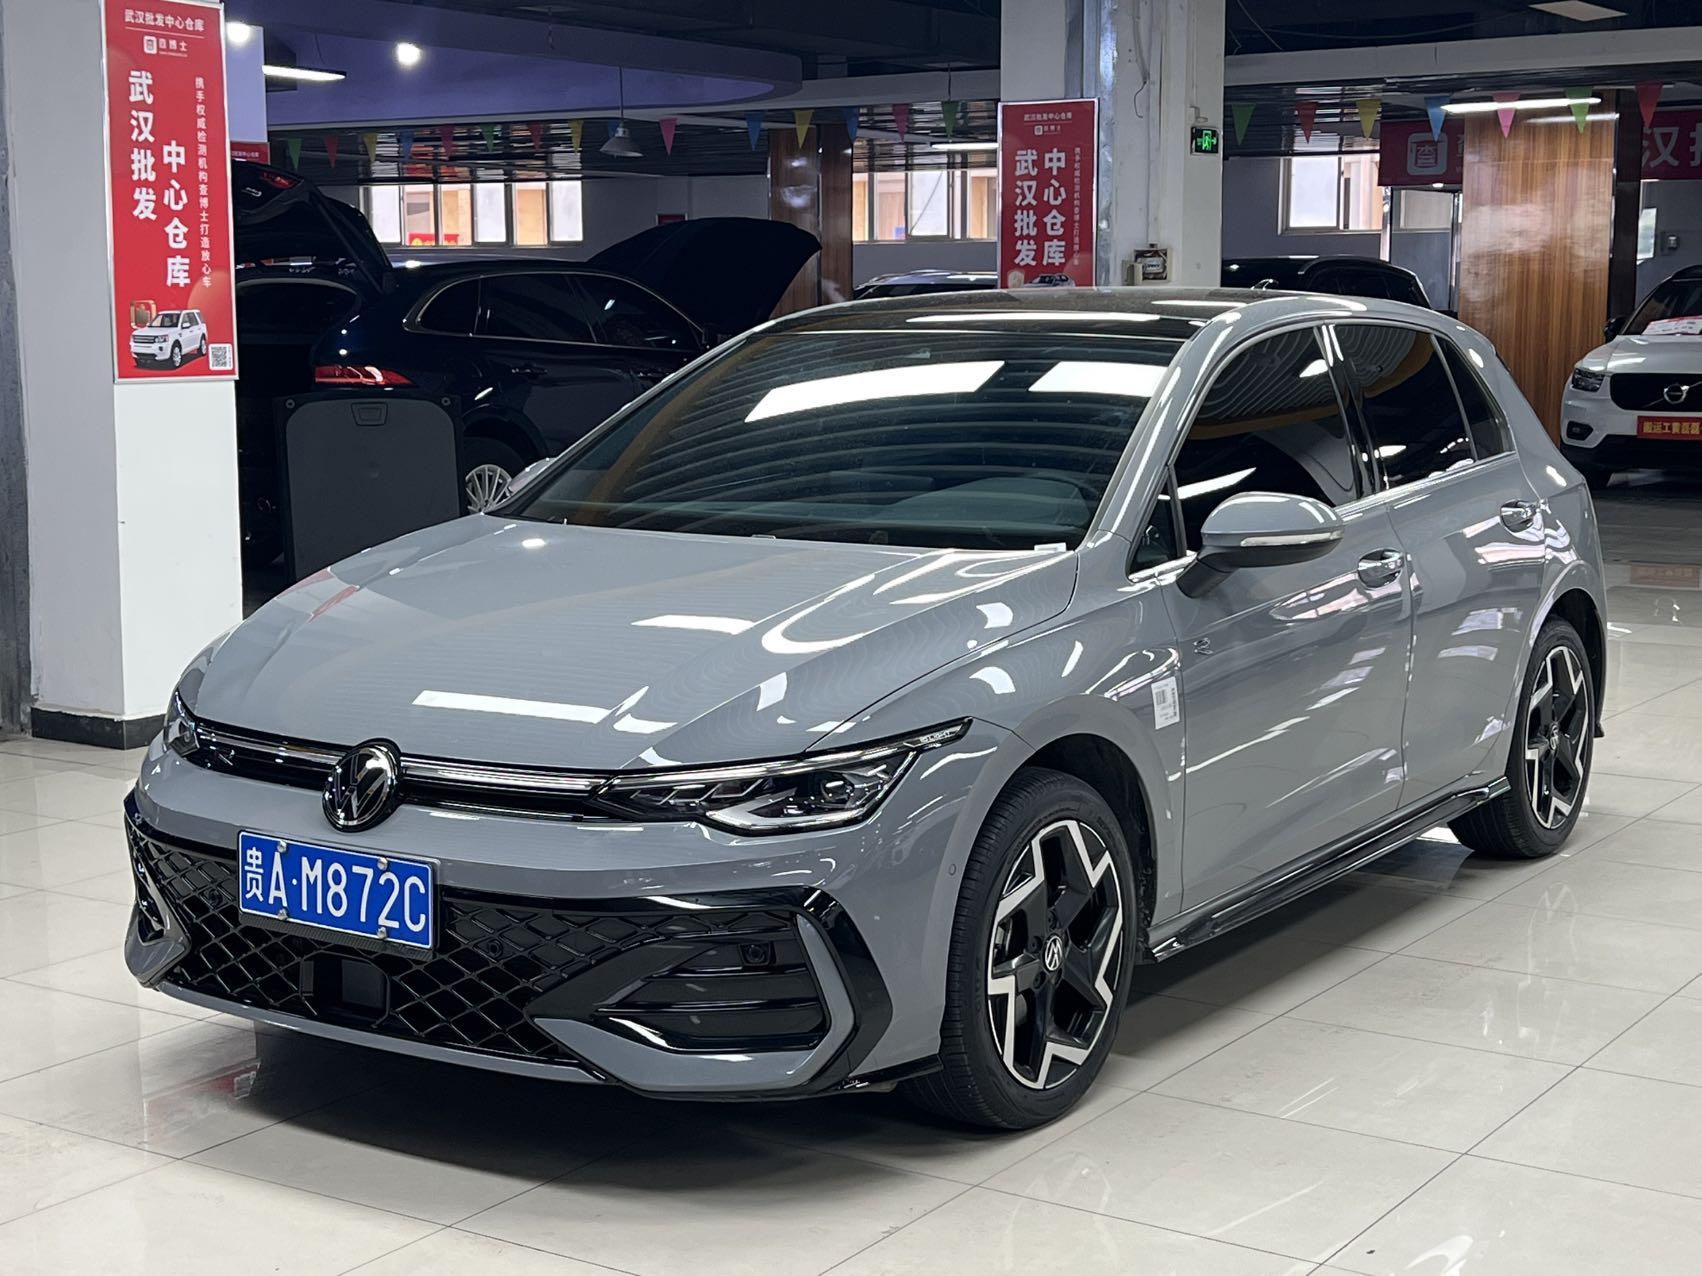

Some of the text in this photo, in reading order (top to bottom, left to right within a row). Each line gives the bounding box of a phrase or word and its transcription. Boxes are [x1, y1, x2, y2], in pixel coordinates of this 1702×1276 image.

[124, 9, 204, 31] 武汉批发中心仓库
[128, 70, 157, 221] 武汉批发
[163, 140, 191, 287] 中心仓库
[1014, 149, 1038, 266] 武汉批发
[1042, 148, 1066, 266] 中心仓库
[244, 846, 426, 933] 贵A·M872C
